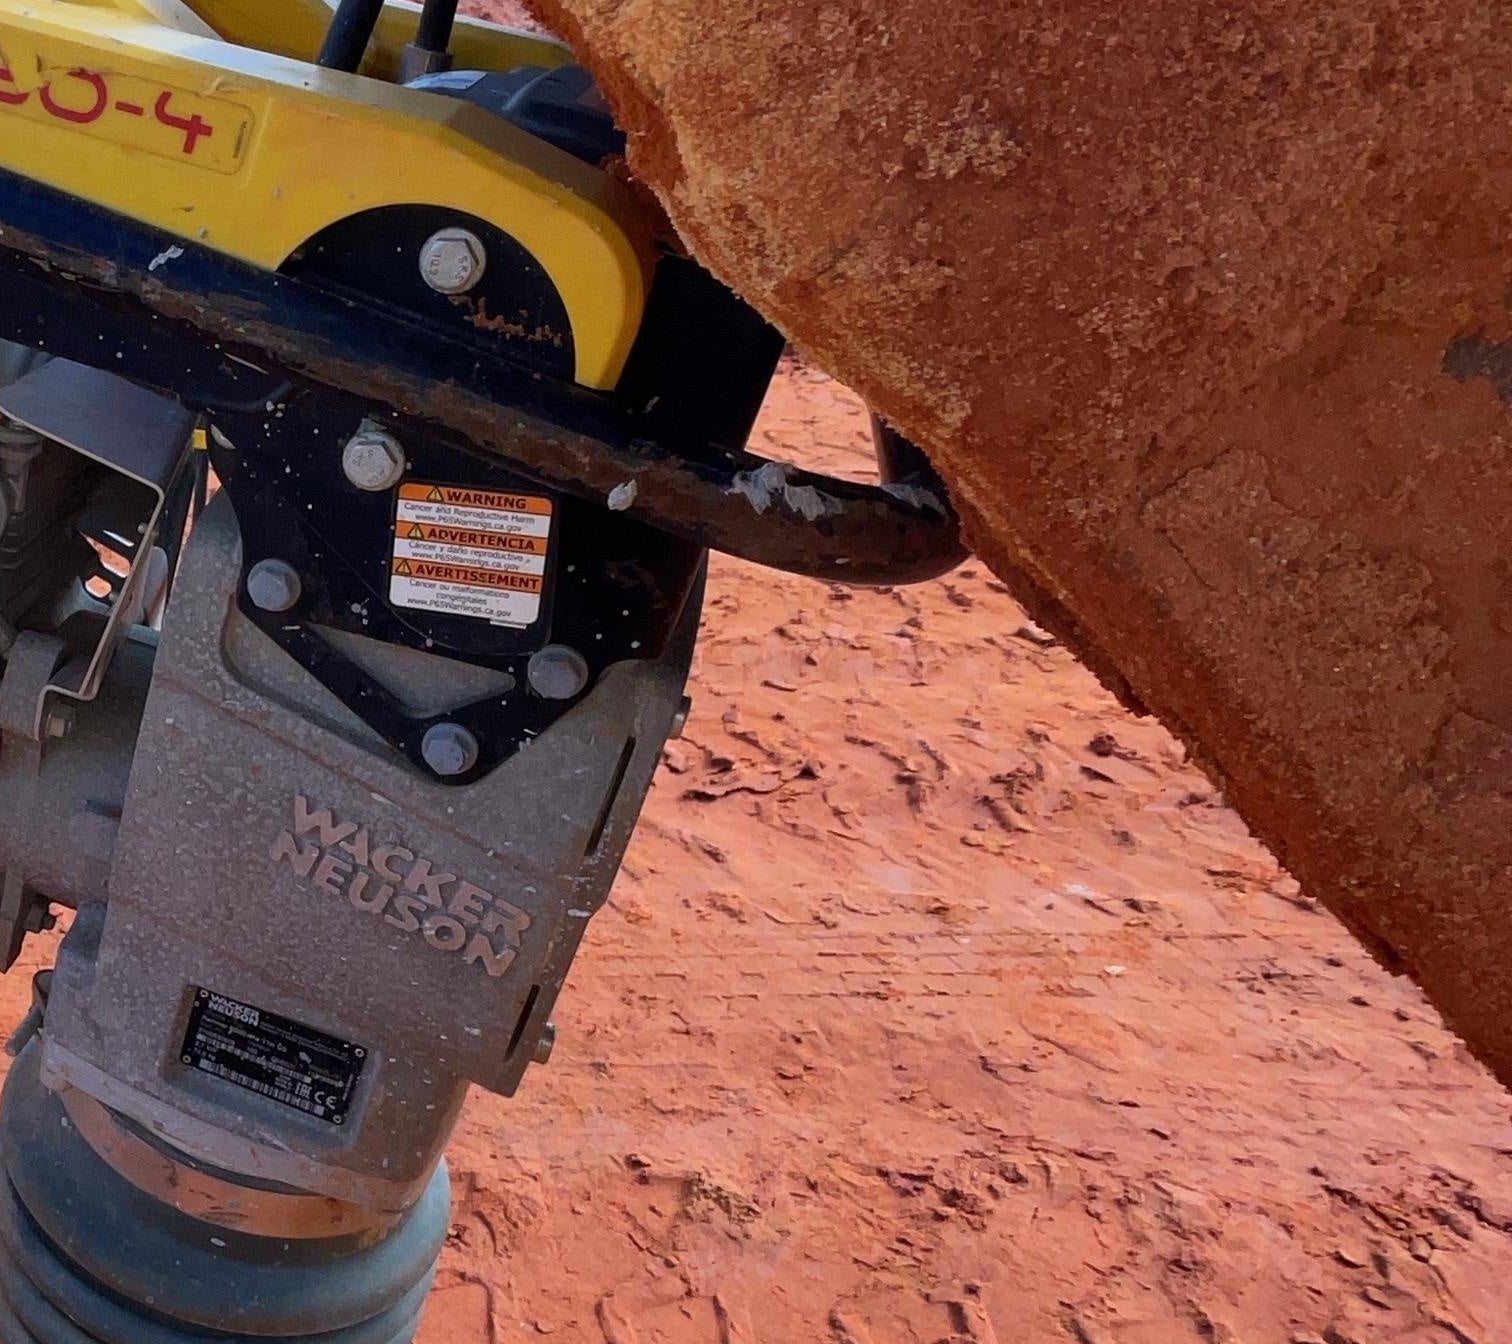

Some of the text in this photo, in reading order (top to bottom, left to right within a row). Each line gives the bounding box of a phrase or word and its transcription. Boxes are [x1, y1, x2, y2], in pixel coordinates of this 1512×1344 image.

[446, 489, 526, 510] WARNING
[403, 502, 535, 523] Cancer and Reproductive Harm
[414, 511, 522, 533] www.P65Warnings.ca.gov
[427, 527, 536, 551] ADVERTENCIA
[411, 550, 520, 571] www.P65Warnings.ca.gov
[415, 563, 539, 590] AVERTISSEMENT
[408, 579, 436, 589] Cancer
[451, 585, 509, 598] malformations
[406, 597, 511, 618] www.P65Warnings.ca.gov
[294, 793, 531, 947] WACKER
[270, 830, 517, 977] NEUSON
[208, 1002, 259, 1026] NEUSON
[210, 993, 259, 1019] WACKER
